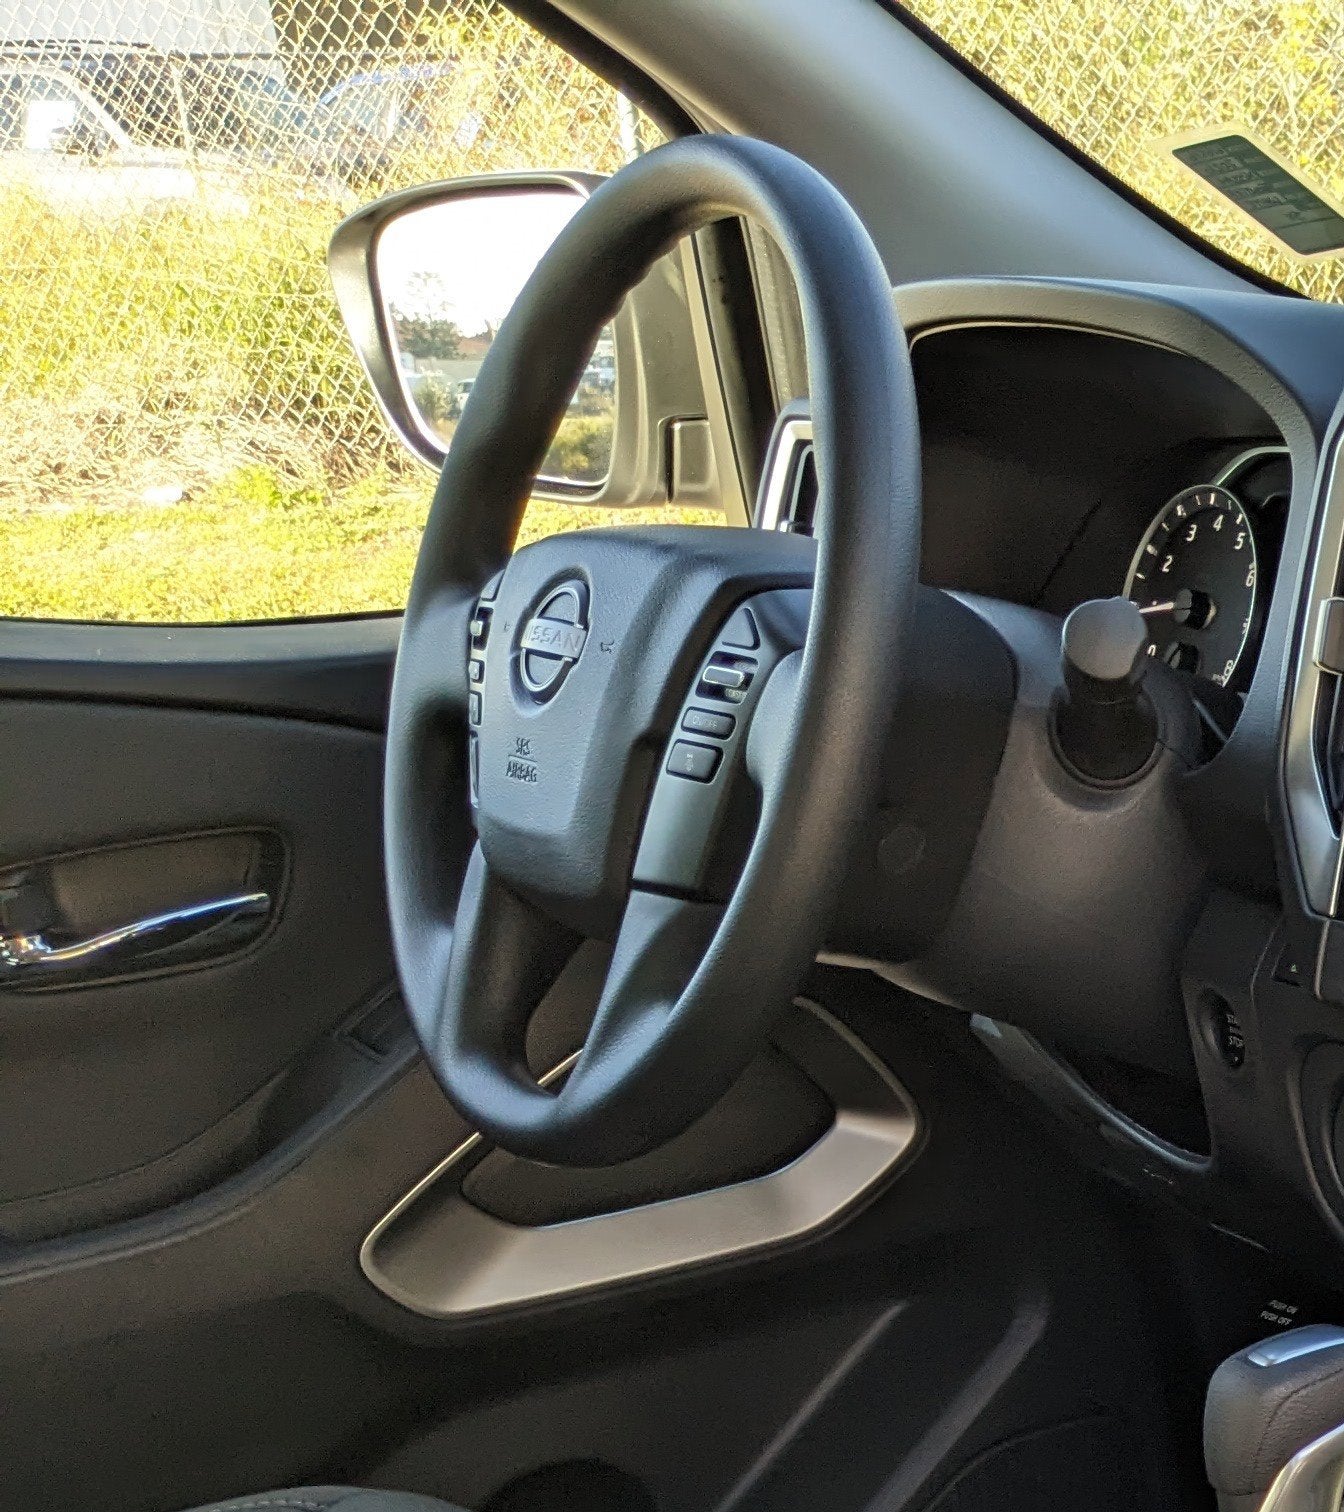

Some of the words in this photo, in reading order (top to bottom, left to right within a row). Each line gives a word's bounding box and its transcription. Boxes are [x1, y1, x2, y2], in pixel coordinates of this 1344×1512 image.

[1213, 515, 1224, 532] 4
[1186, 524, 1197, 542] 3
[1235, 533, 1247, 550] 5
[1162, 555, 1173, 573] 2
[1246, 570, 1255, 587] 6
[506, 761, 538, 782] AIRBAG
